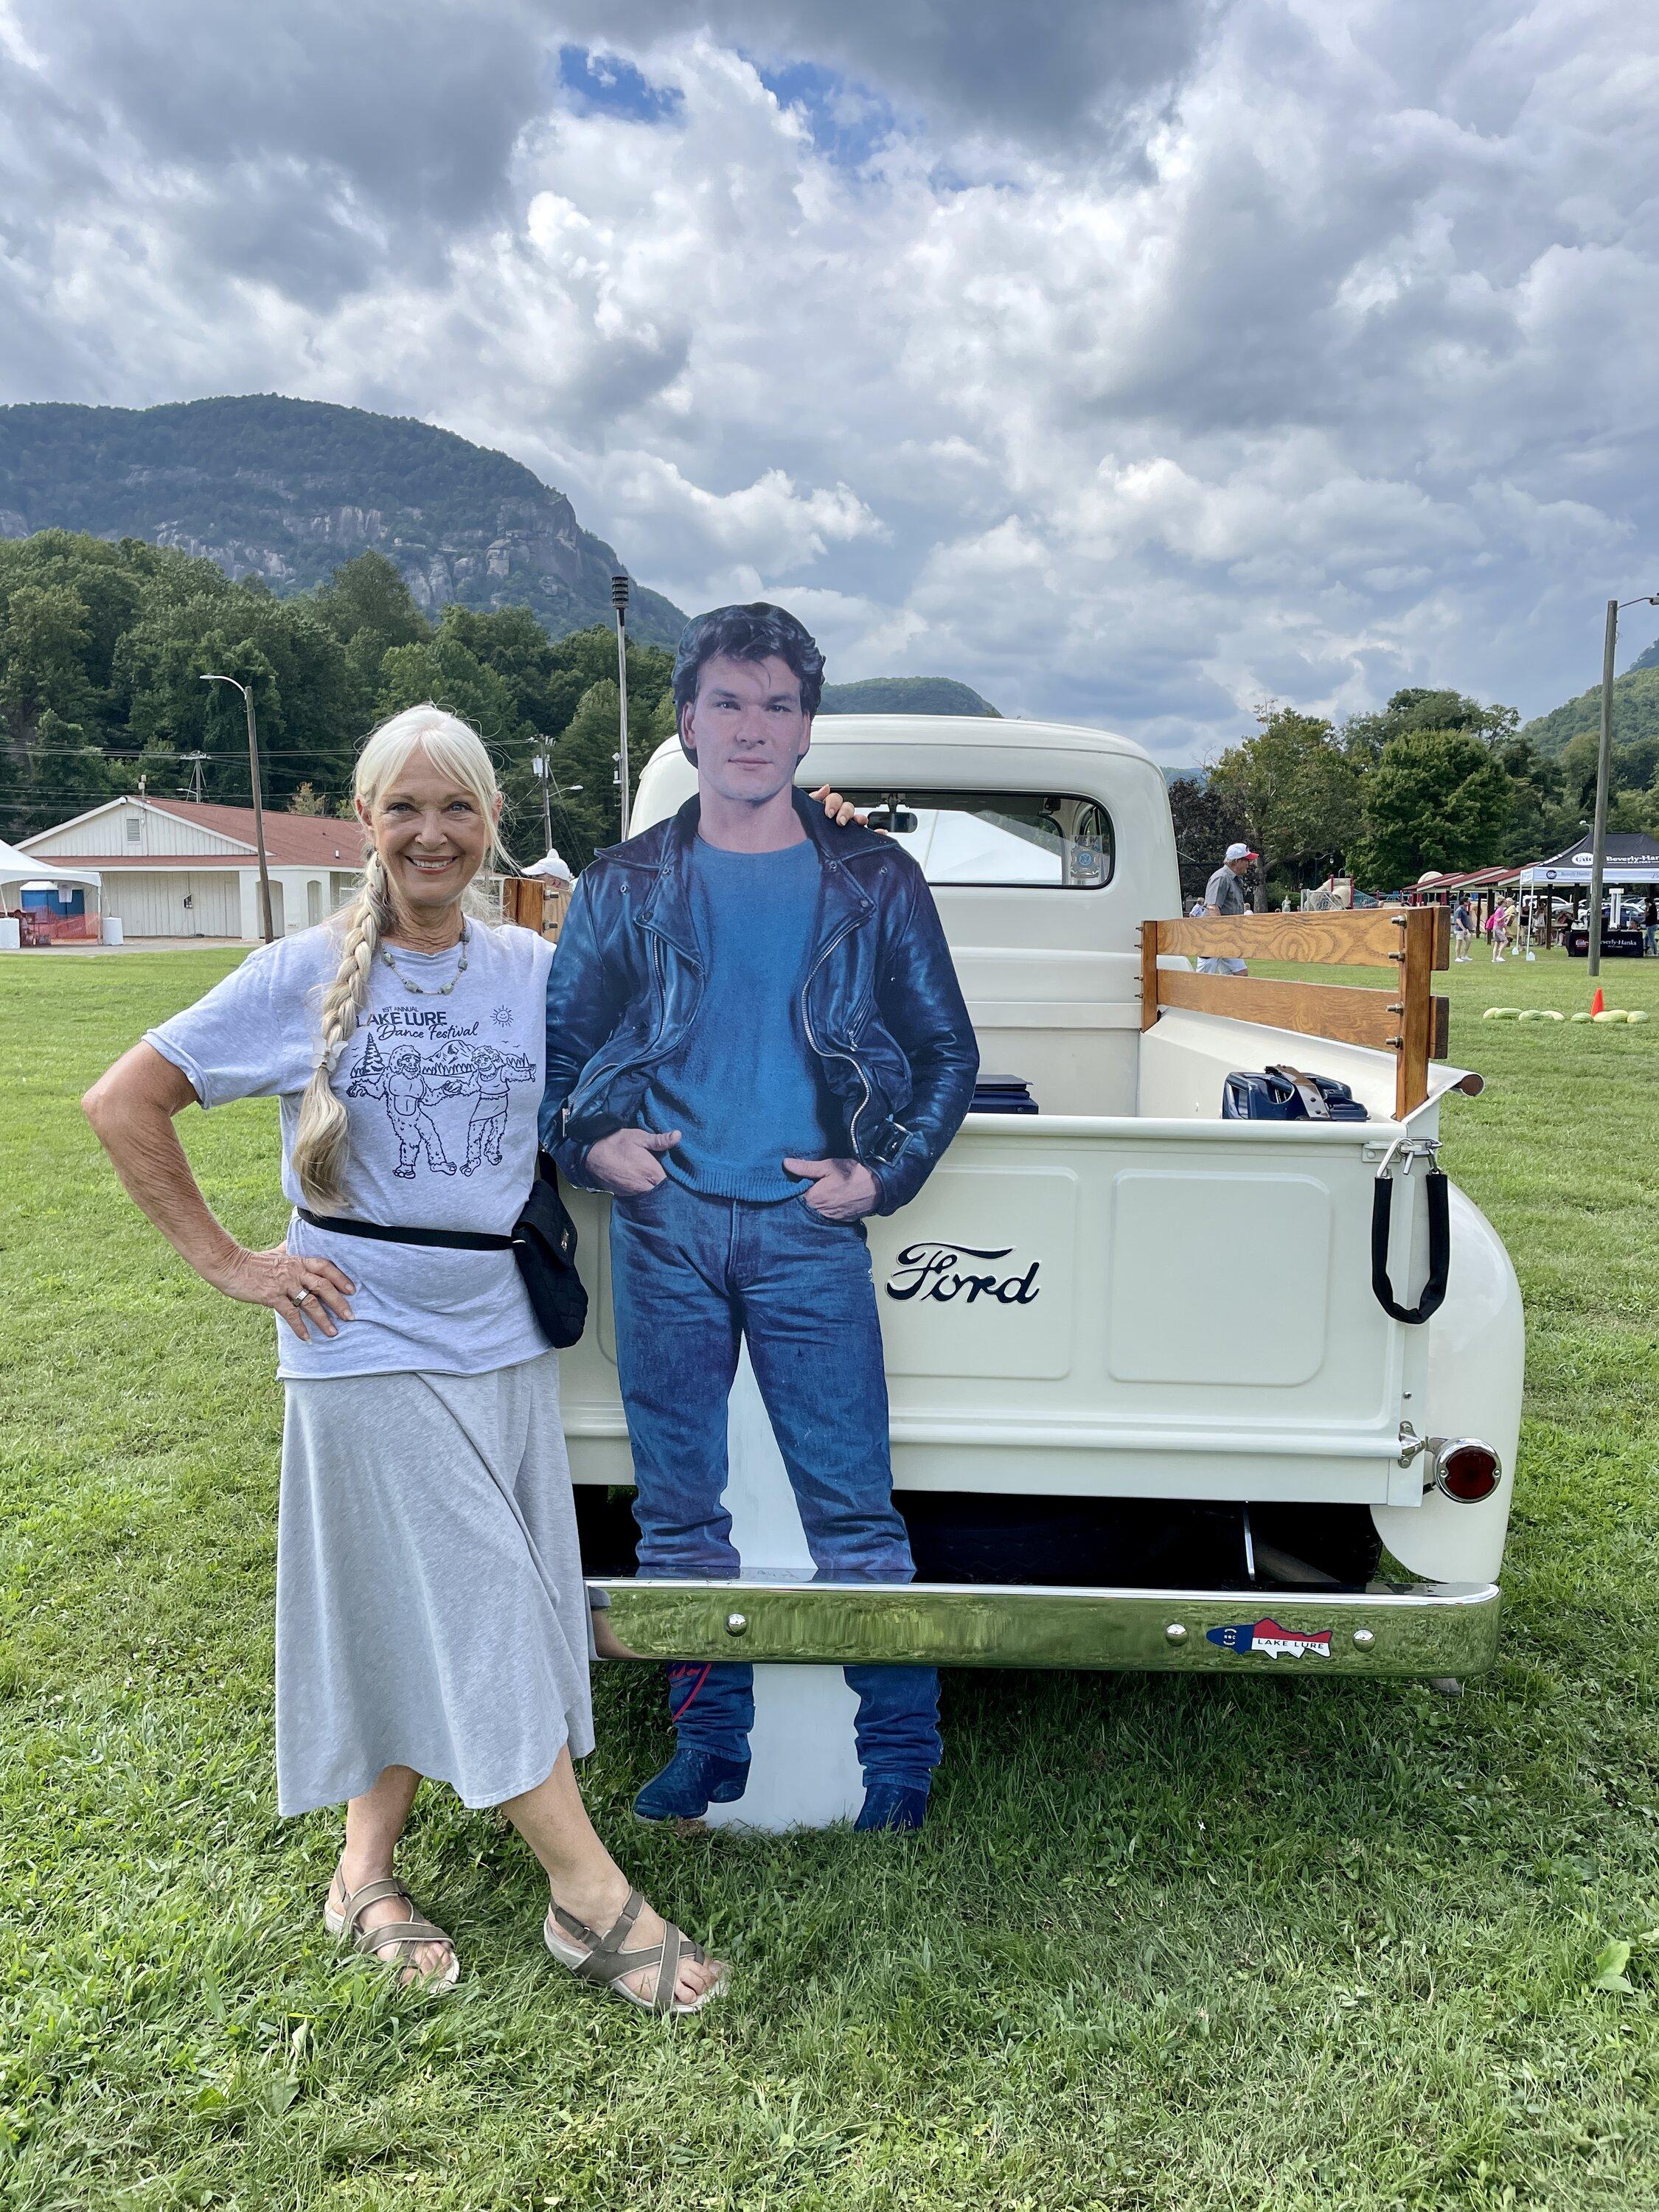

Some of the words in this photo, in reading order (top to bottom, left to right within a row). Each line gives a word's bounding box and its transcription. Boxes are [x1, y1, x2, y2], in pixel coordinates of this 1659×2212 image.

[355, 1012, 403, 1028] LAKE
[405, 1011, 448, 1026] LURE
[377, 1023, 424, 1040] Dance
[428, 1021, 479, 1040] Festival
[886, 1242, 1041, 1304] Ford
[1258, 1638, 1289, 1646] LAKE
[1294, 1641, 1324, 1649] LURE
